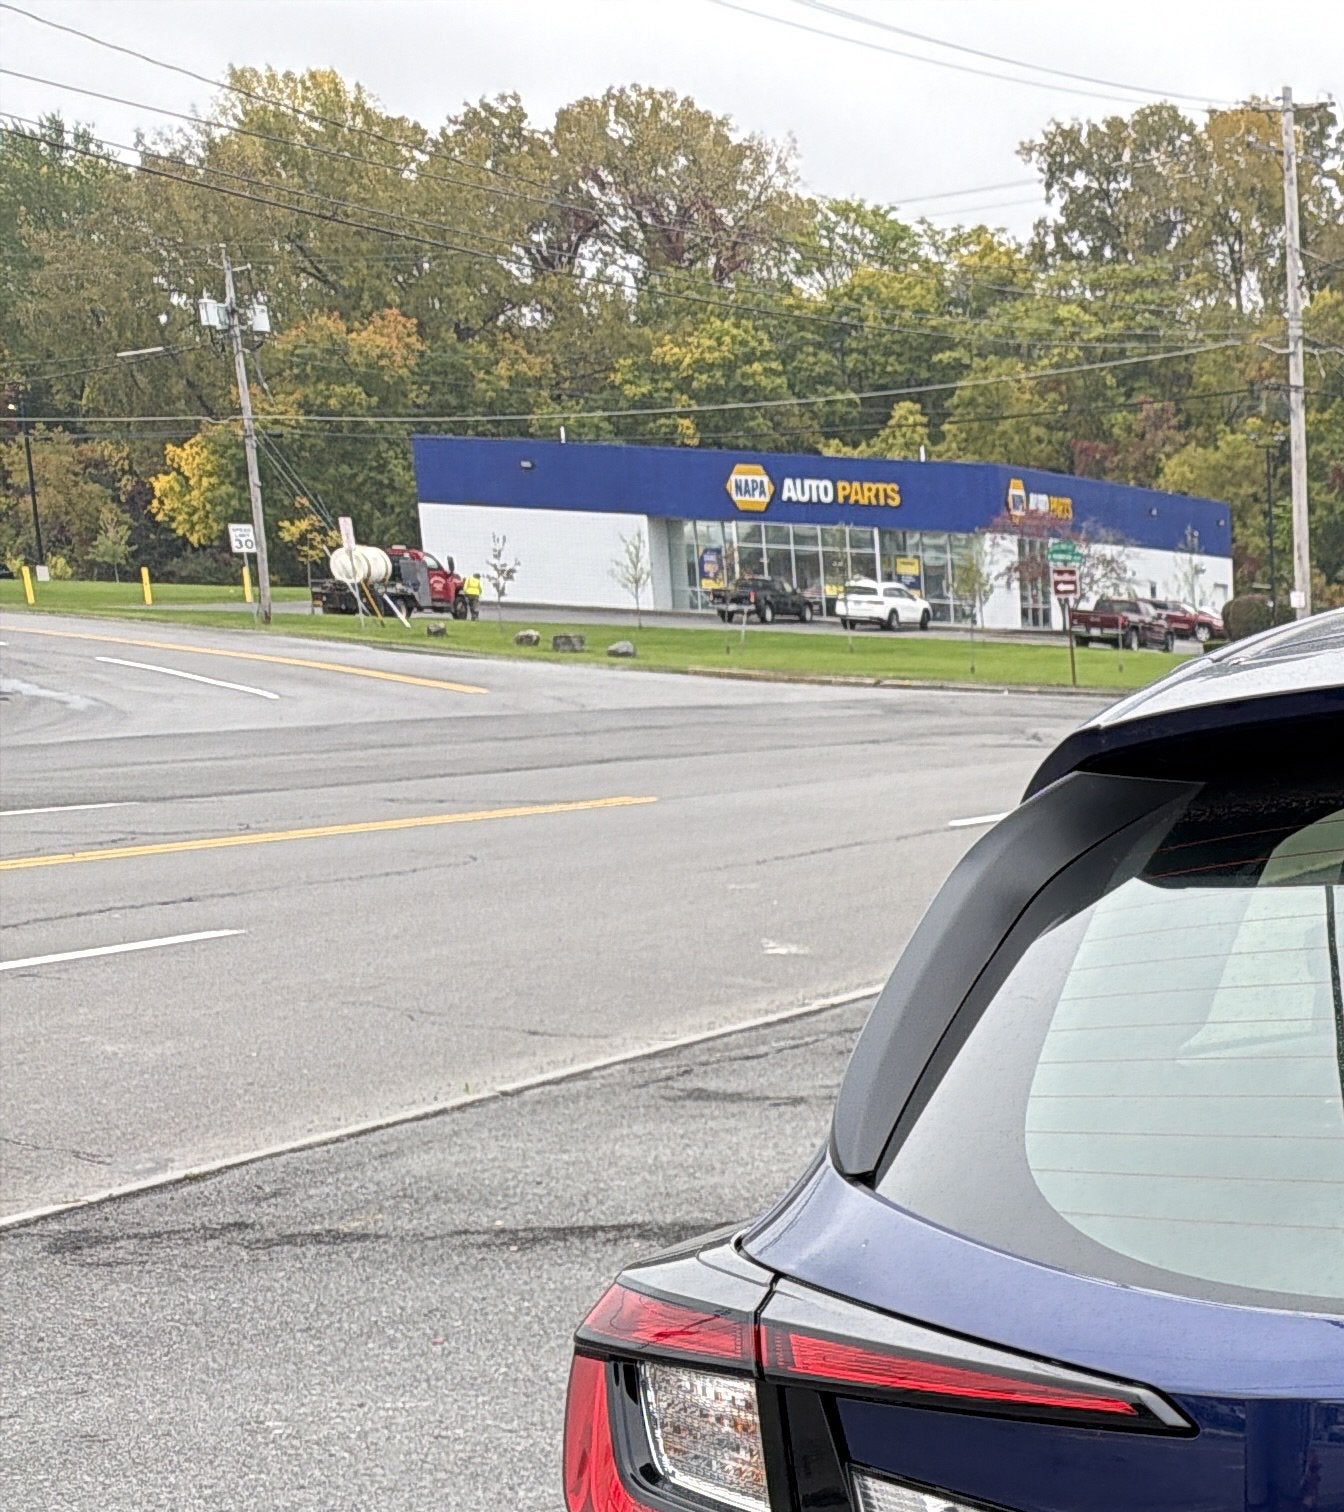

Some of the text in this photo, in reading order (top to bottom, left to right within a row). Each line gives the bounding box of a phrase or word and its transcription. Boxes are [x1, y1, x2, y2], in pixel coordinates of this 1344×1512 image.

[734, 478, 901, 507] NAPA AUTO PARTS
[234, 538, 254, 550] 30
